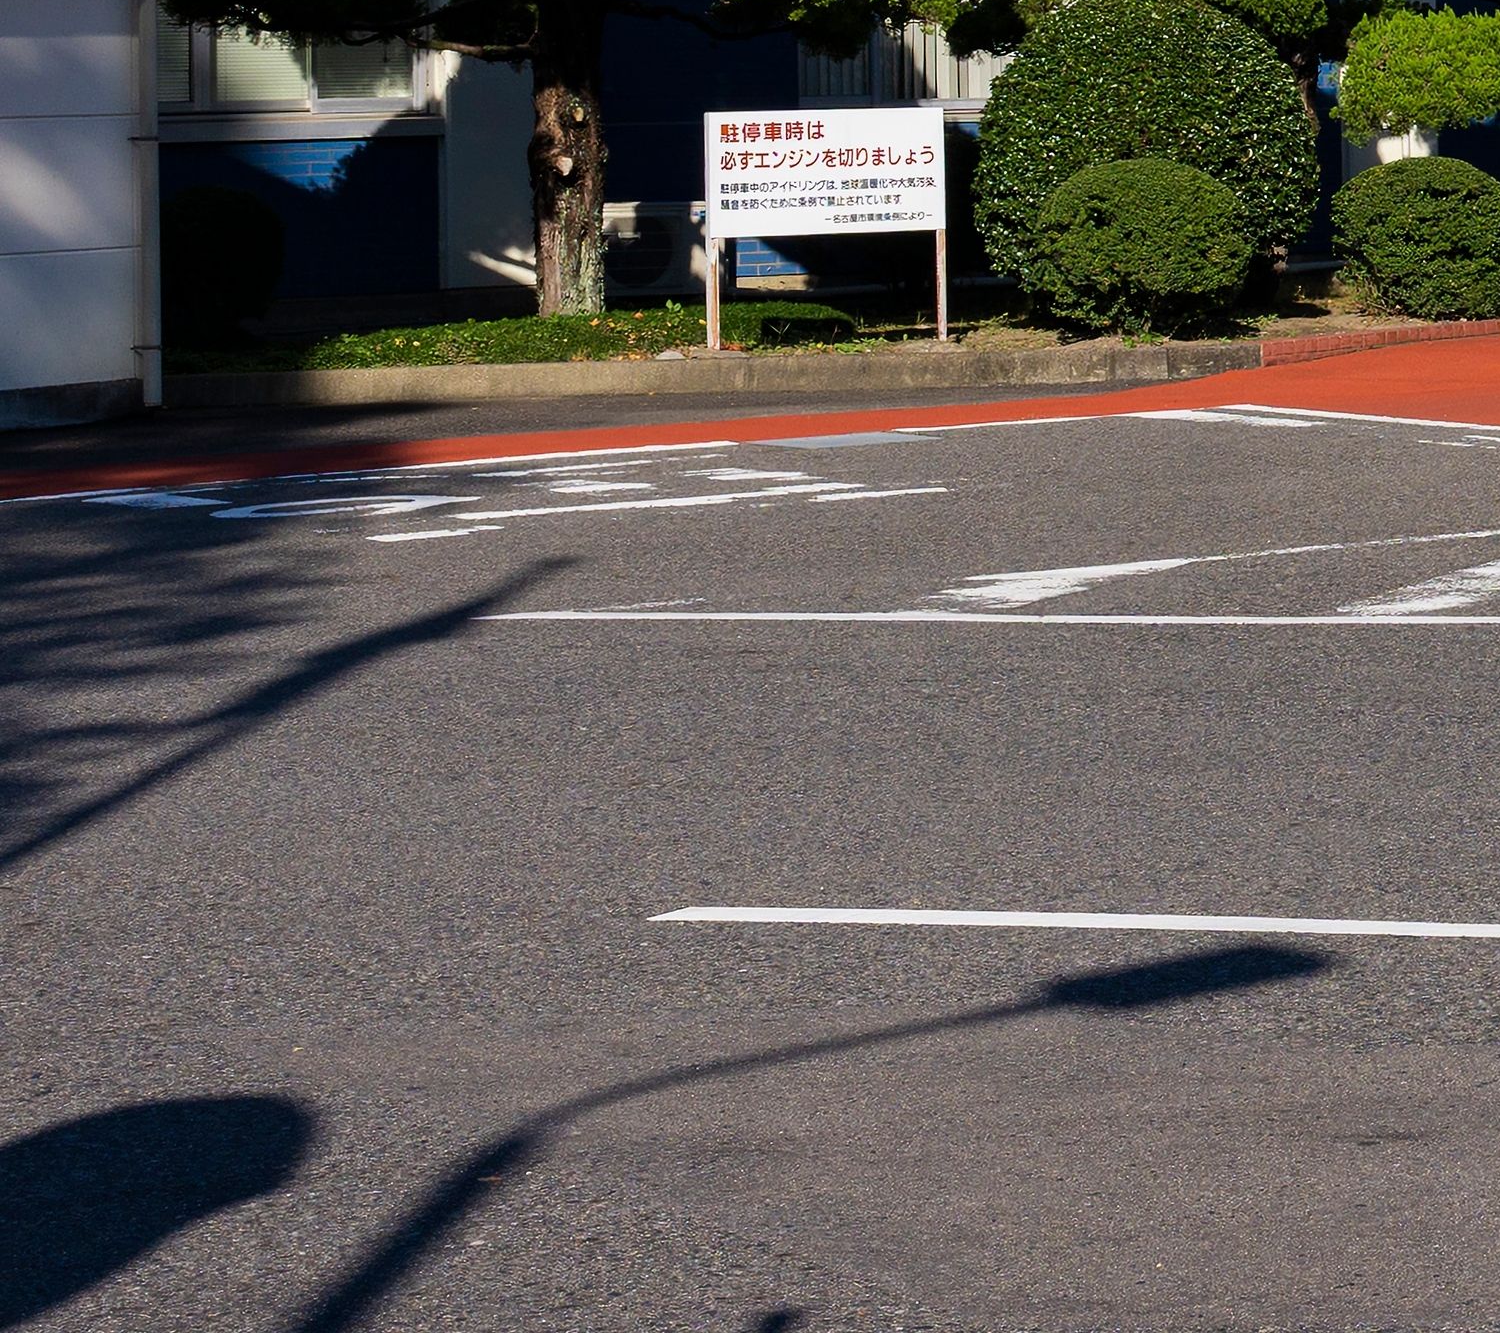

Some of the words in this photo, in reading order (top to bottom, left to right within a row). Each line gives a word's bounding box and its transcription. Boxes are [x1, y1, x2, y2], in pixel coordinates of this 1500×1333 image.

[720, 120, 825, 143] 駐停車時は
[720, 146, 935, 171] 必ずエンジンを切りましょう
